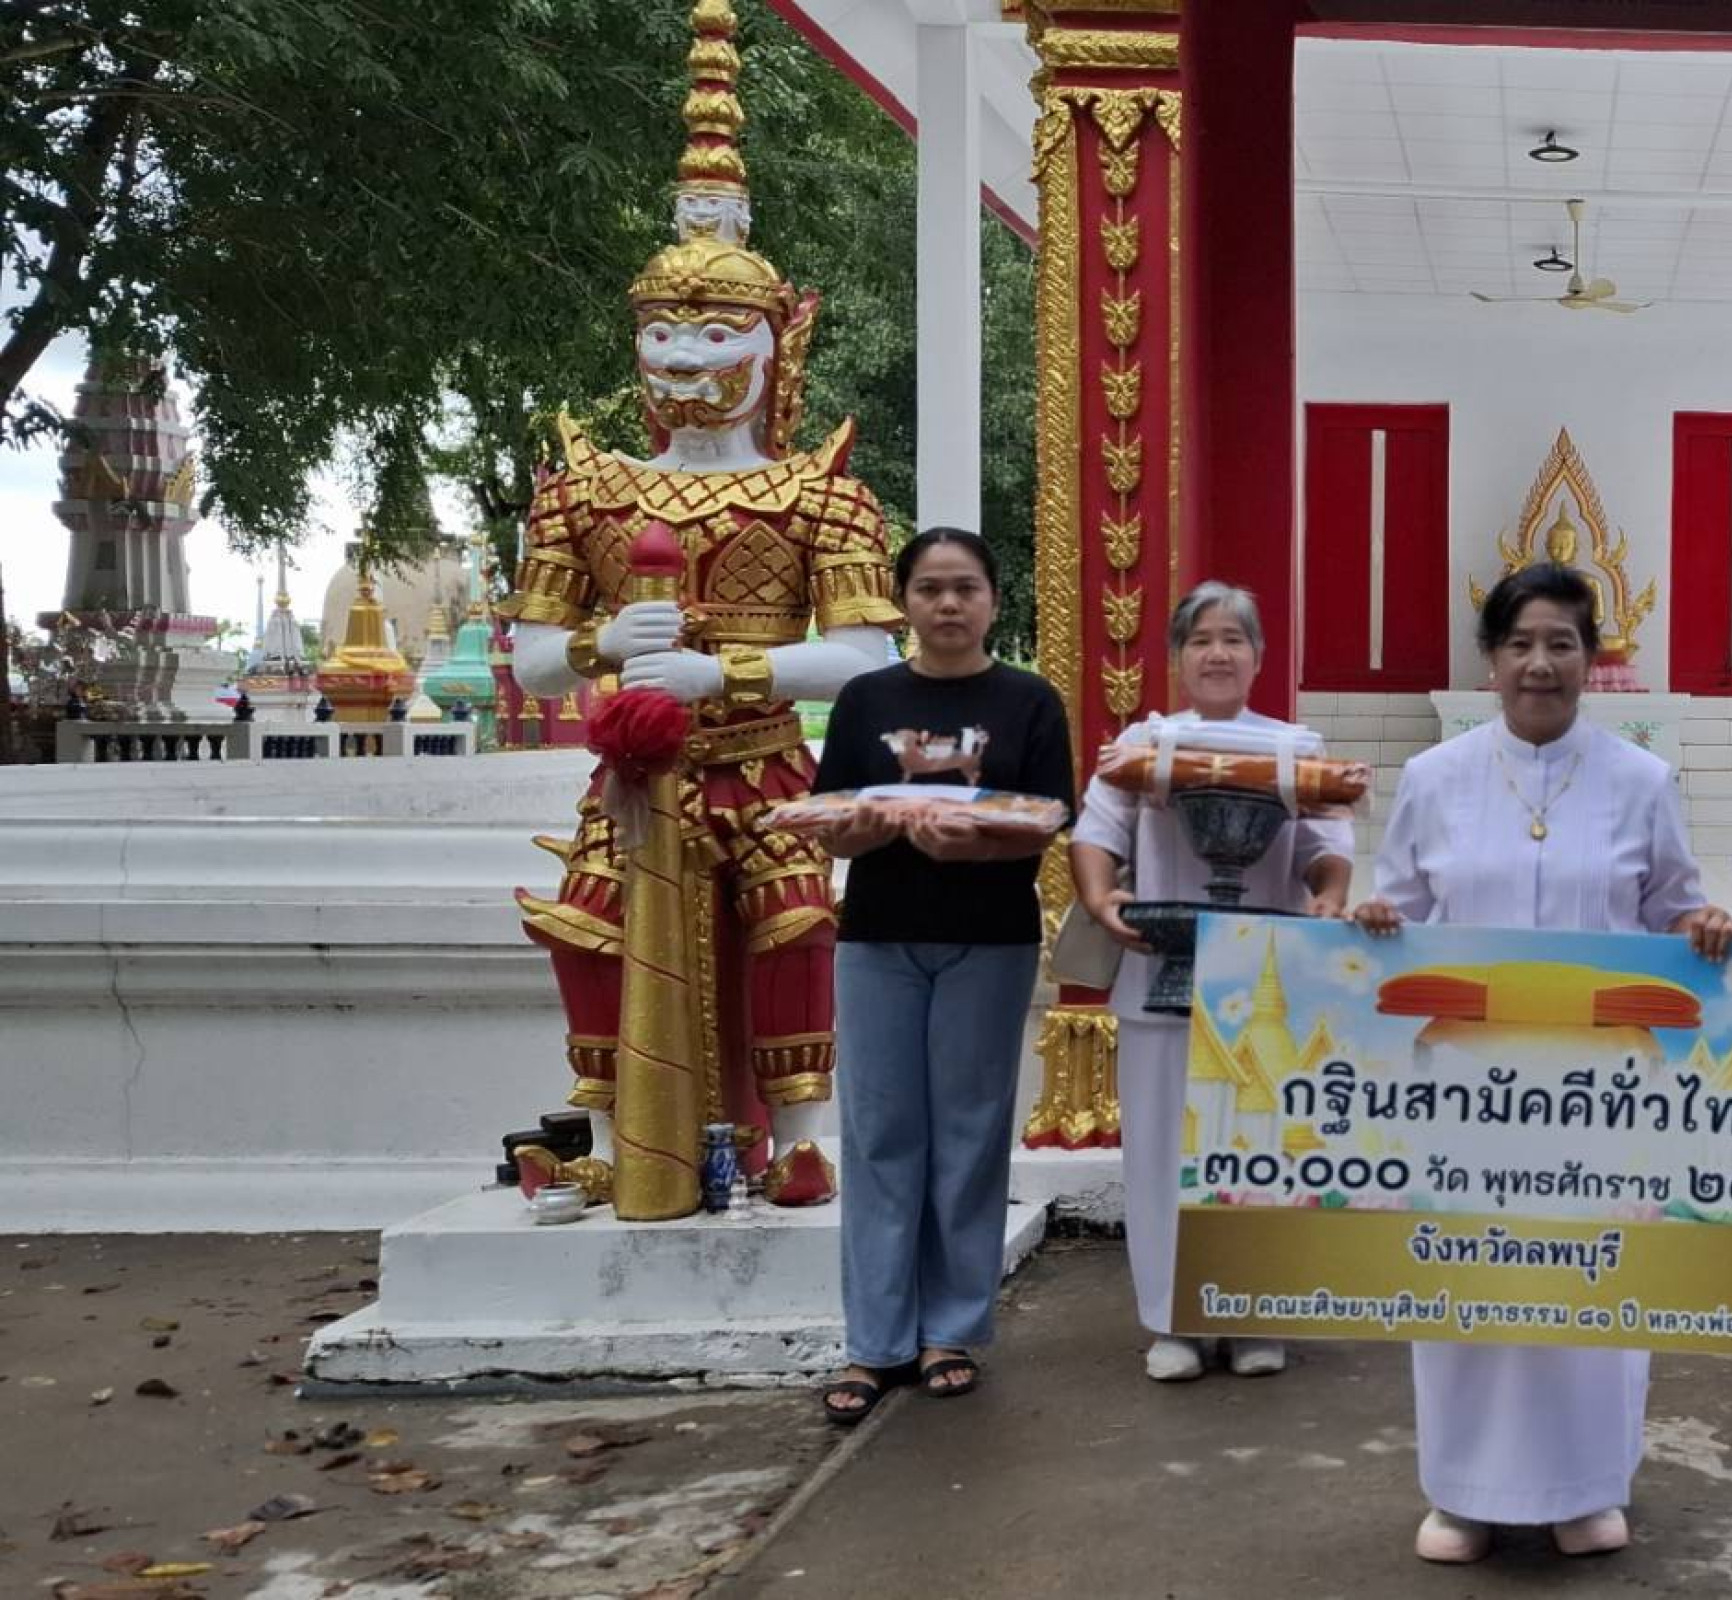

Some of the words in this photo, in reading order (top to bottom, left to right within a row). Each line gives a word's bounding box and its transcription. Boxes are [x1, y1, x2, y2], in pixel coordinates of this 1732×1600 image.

[1204, 1152, 1411, 1196] ๓๐,๐๐๐
[1426, 1153, 1470, 1194] วัด
[1481, 1160, 1671, 1208] พุทธศักราช
[1411, 1223, 1622, 1282] จังหวัดลพบุรี
[1202, 1285, 1249, 1317] โดย
[1256, 1288, 1449, 1328] คณะศิษยานุศิษย์
[1456, 1301, 1569, 1331] บูชาธรรม
[1577, 1308, 1612, 1328] ๘๑
[1620, 1300, 1639, 1329] ปี
